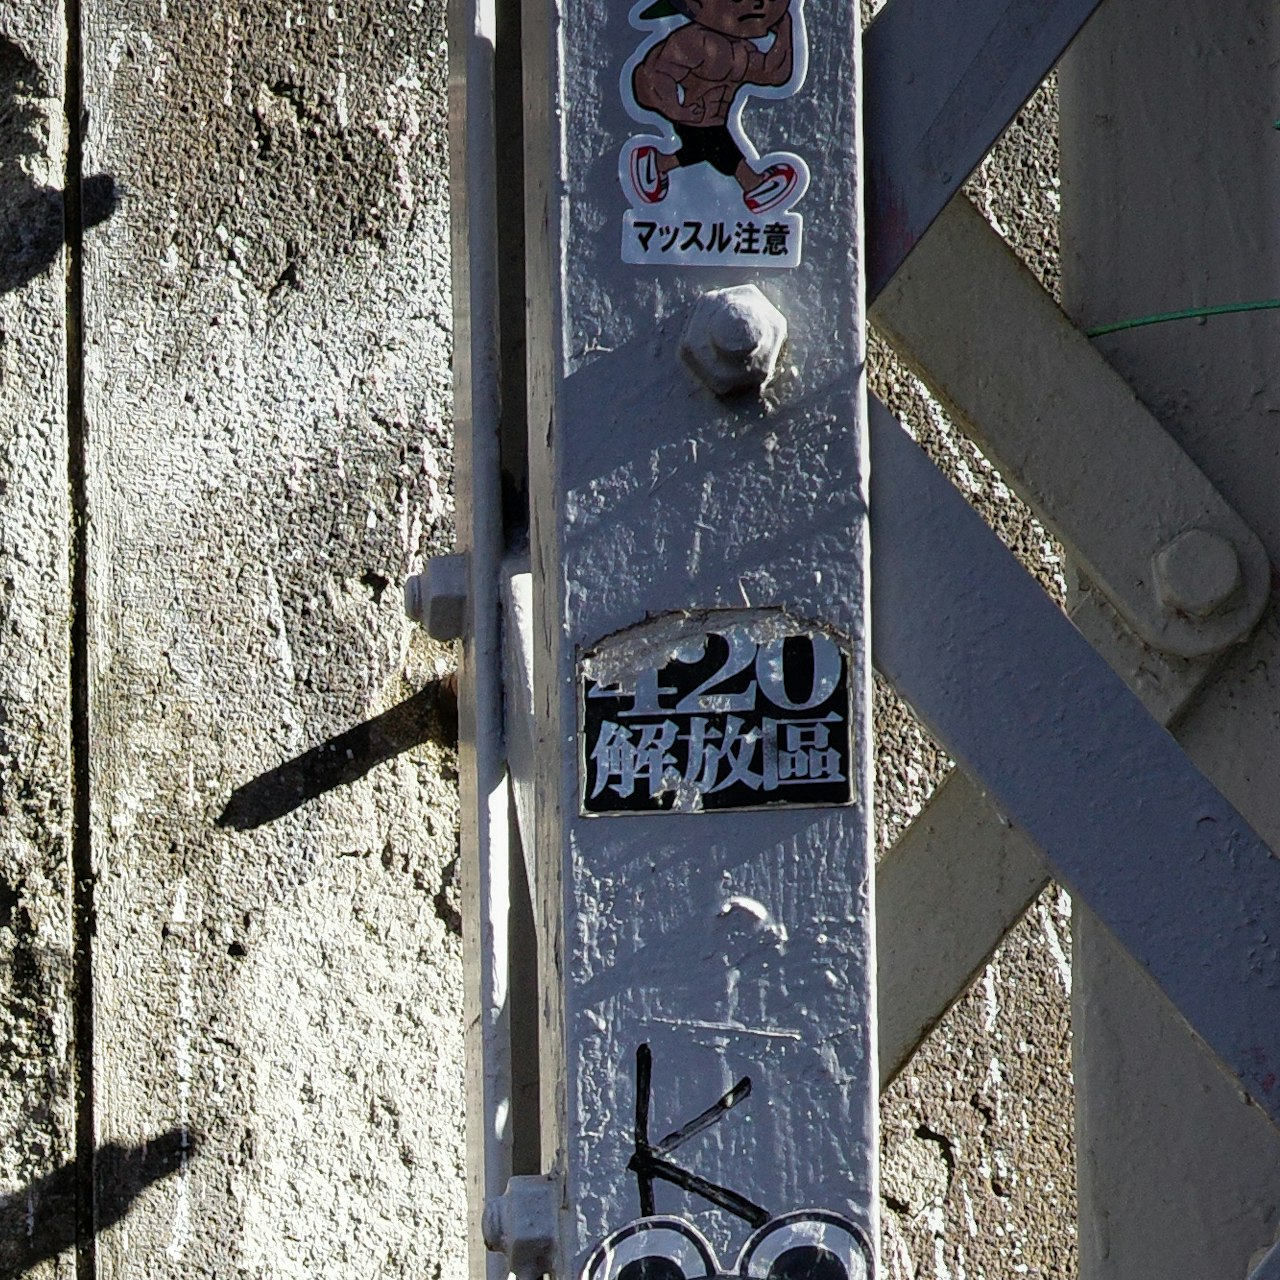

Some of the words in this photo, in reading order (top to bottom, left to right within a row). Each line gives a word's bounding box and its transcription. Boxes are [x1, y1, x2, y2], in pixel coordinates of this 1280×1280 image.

[633, 221, 790, 256] マッスル注意
[590, 711, 847, 799] 解放區
